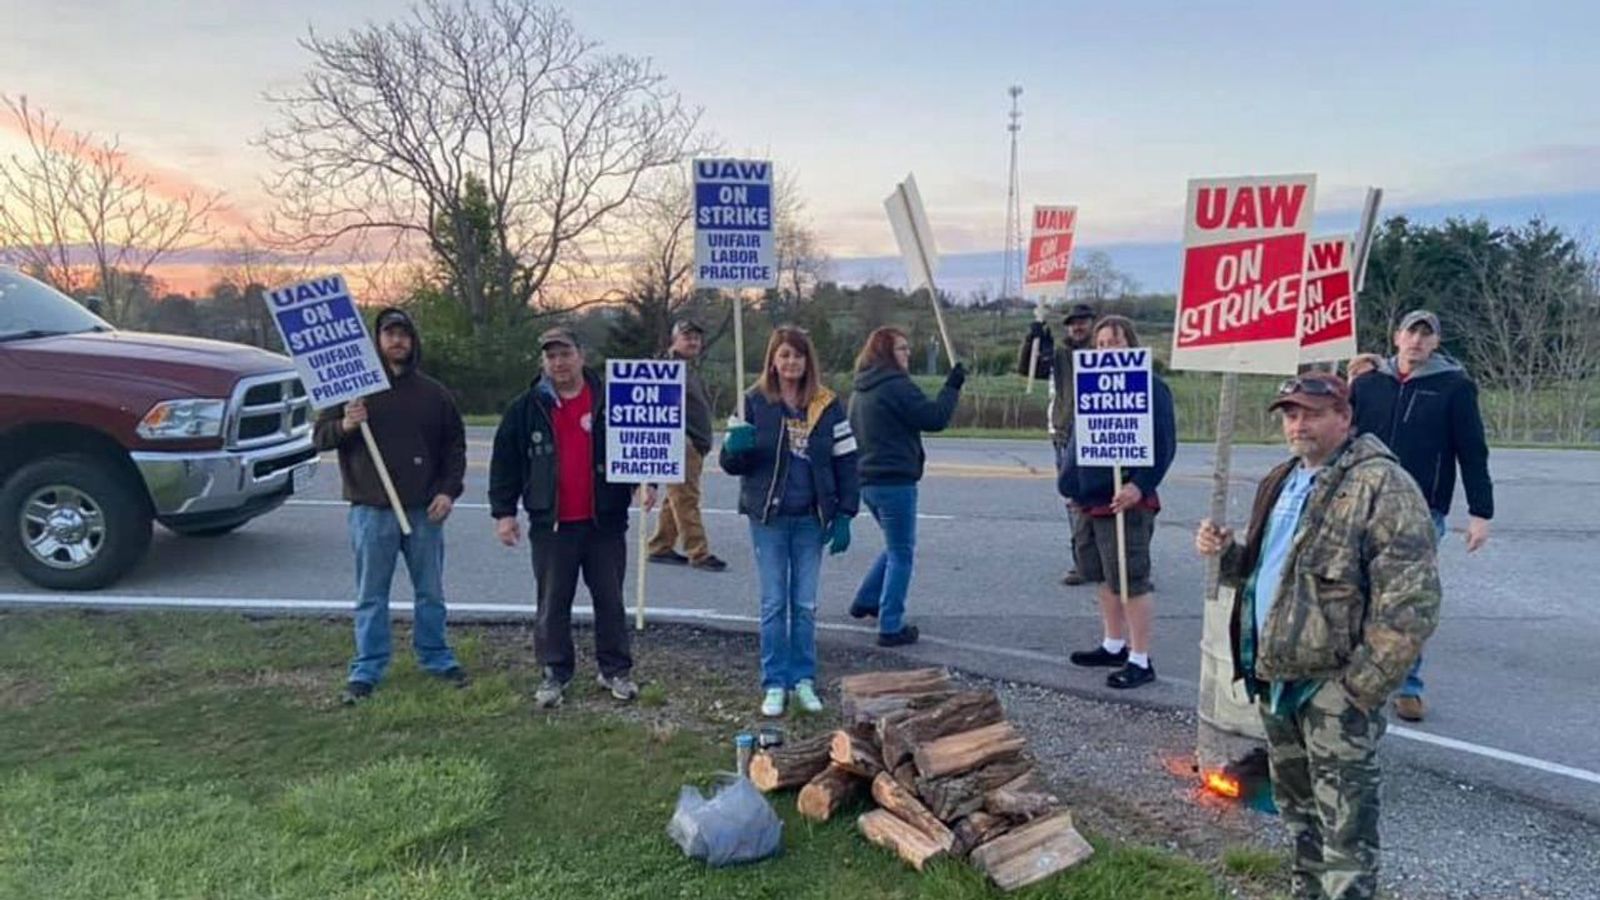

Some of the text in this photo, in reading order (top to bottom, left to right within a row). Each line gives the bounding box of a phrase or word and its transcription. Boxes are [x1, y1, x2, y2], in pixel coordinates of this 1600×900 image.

[698, 161, 767, 180] UAW
[719, 186, 748, 205] ON
[699, 206, 769, 226] STRIKE
[1195, 184, 1307, 230] UAW
[1036, 210, 1074, 230] UAW
[708, 233, 761, 248] UNFAIR
[1040, 237, 1058, 258] ON
[711, 250, 759, 264] LABOR
[1028, 250, 1069, 281] STRIKE
[700, 265, 770, 280] PRACTICE
[1215, 243, 1264, 291] ON
[270, 277, 340, 307] UAW
[302, 302, 333, 325] ON
[1179, 273, 1301, 343] STRIKE
[1303, 295, 1351, 335] RIKE
[289, 317, 361, 350] STRIKE
[308, 343, 362, 369] UNFAIR
[1080, 351, 1146, 369] UAW
[317, 359, 366, 382] LABOR
[613, 362, 680, 380] UAW
[312, 370, 382, 401] PRACTICE
[1098, 373, 1126, 391] ON
[631, 386, 659, 404] ON
[1079, 392, 1147, 410] STRIKE
[611, 405, 679, 423] STRIKE
[1088, 417, 1138, 431] UNFAIR
[619, 431, 671, 445] UNFAIR
[1091, 432, 1137, 445] LABOR
[622, 447, 668, 460] LABOR
[1081, 446, 1147, 459] PRACTICE
[611, 461, 680, 475] PRACTICE
